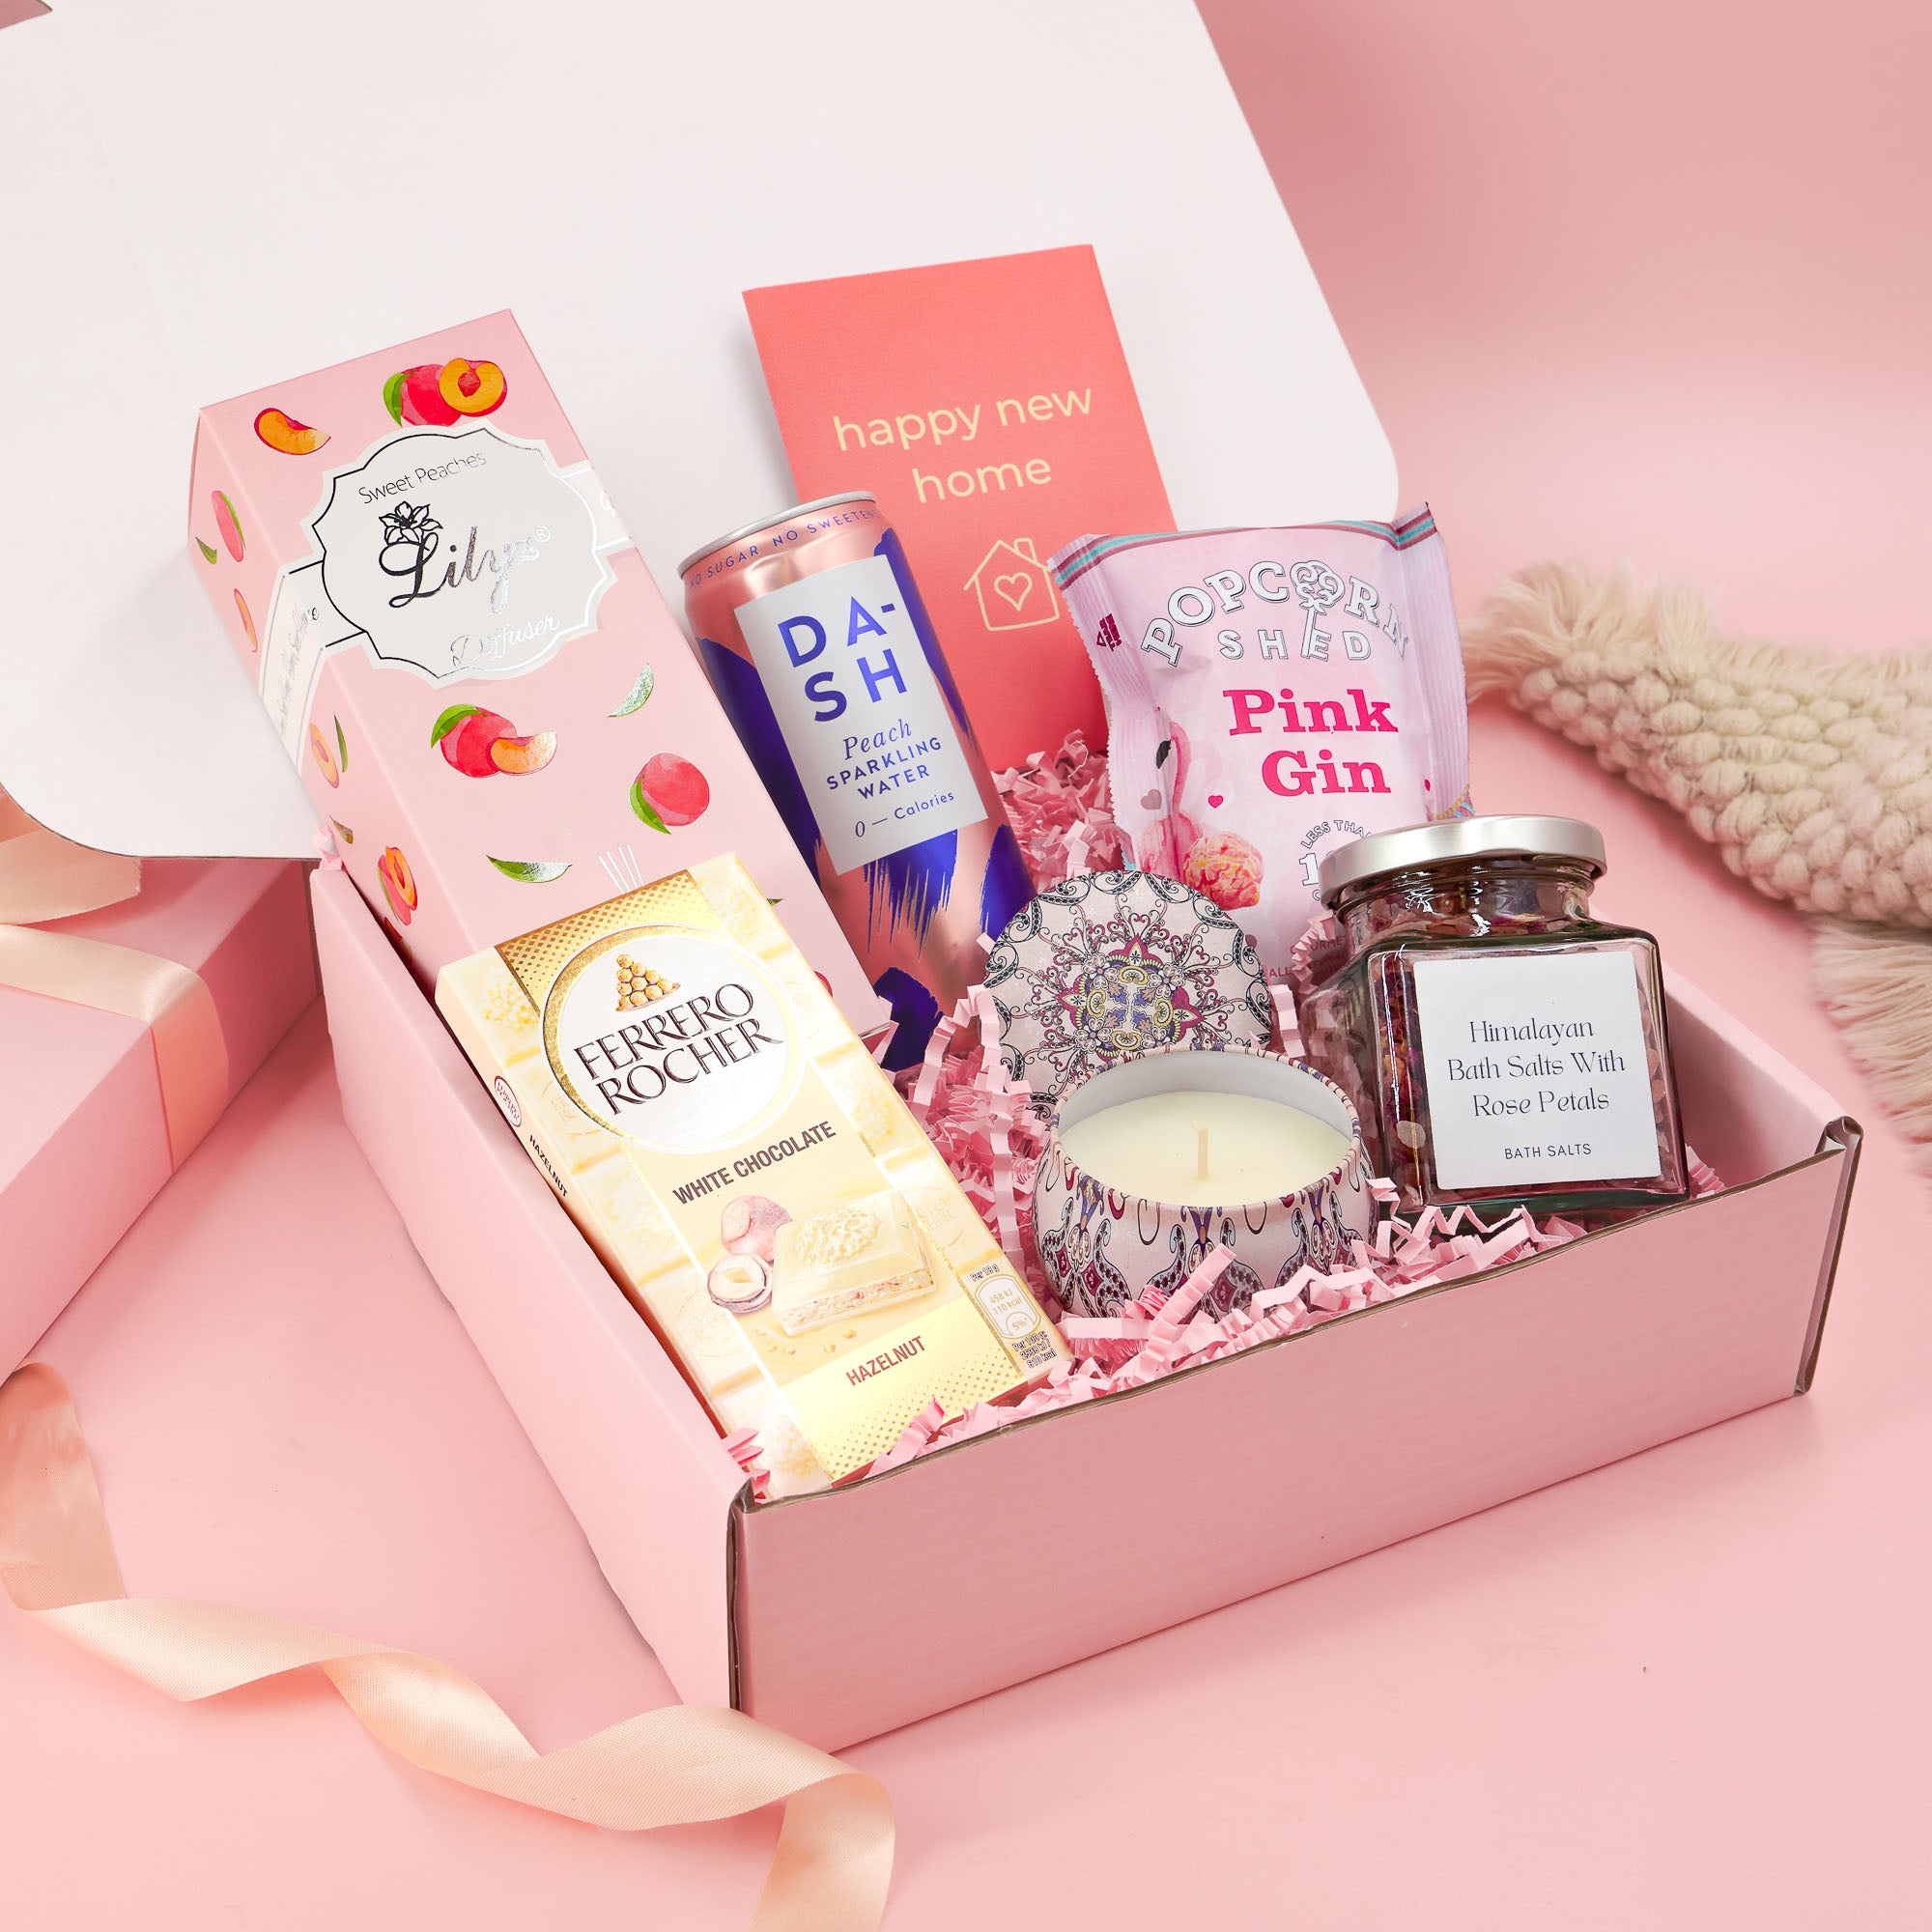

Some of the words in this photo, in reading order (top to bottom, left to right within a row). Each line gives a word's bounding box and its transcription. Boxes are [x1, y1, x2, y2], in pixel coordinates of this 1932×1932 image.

[833, 404, 980, 451] happy
[996, 388, 1092, 426] new
[358, 474, 415, 504] Sweet
[415, 453, 487, 484] Peaches
[912, 458, 1052, 503] home
[690, 573, 702, 587] NO
[707, 546, 758, 578] SUGAR
[773, 530, 798, 547] NO
[1141, 560, 1409, 668] POPCORN
[450, 615, 560, 667] Diffuser
[1218, 629, 1372, 664] SHED
[1222, 688, 1399, 736] Pink
[826, 737, 942, 790] SPARKLING
[842, 719, 912, 761] Peach
[858, 764, 929, 800] WATER
[1262, 749, 1392, 797] Gin
[854, 821, 866, 838] 0
[894, 791, 955, 820] Calories
[1300, 821, 1331, 850] LESS
[573, 983, 753, 1080] FERRERO
[1469, 1017, 1594, 1046] Himalayan
[595, 1018, 784, 1115] ROCHER
[1448, 1055, 1501, 1081] Bath
[1507, 1053, 1564, 1078] Salts
[1570, 1049, 1626, 1074] With
[1472, 1094, 1531, 1118] Rose
[1538, 1088, 1609, 1113] Petals
[529, 1134, 568, 1197] HAZELNUT
[672, 1167, 734, 1205] WHITE
[732, 1121, 837, 1178] CHOCOLATE
[1504, 1146, 1541, 1160] BATH
[1548, 1143, 1592, 1156] SALTS
[992, 1303, 1008, 1314] 110
[1007, 1296, 1022, 1307] kcal
[845, 1336, 925, 1386] HAZELNUT
